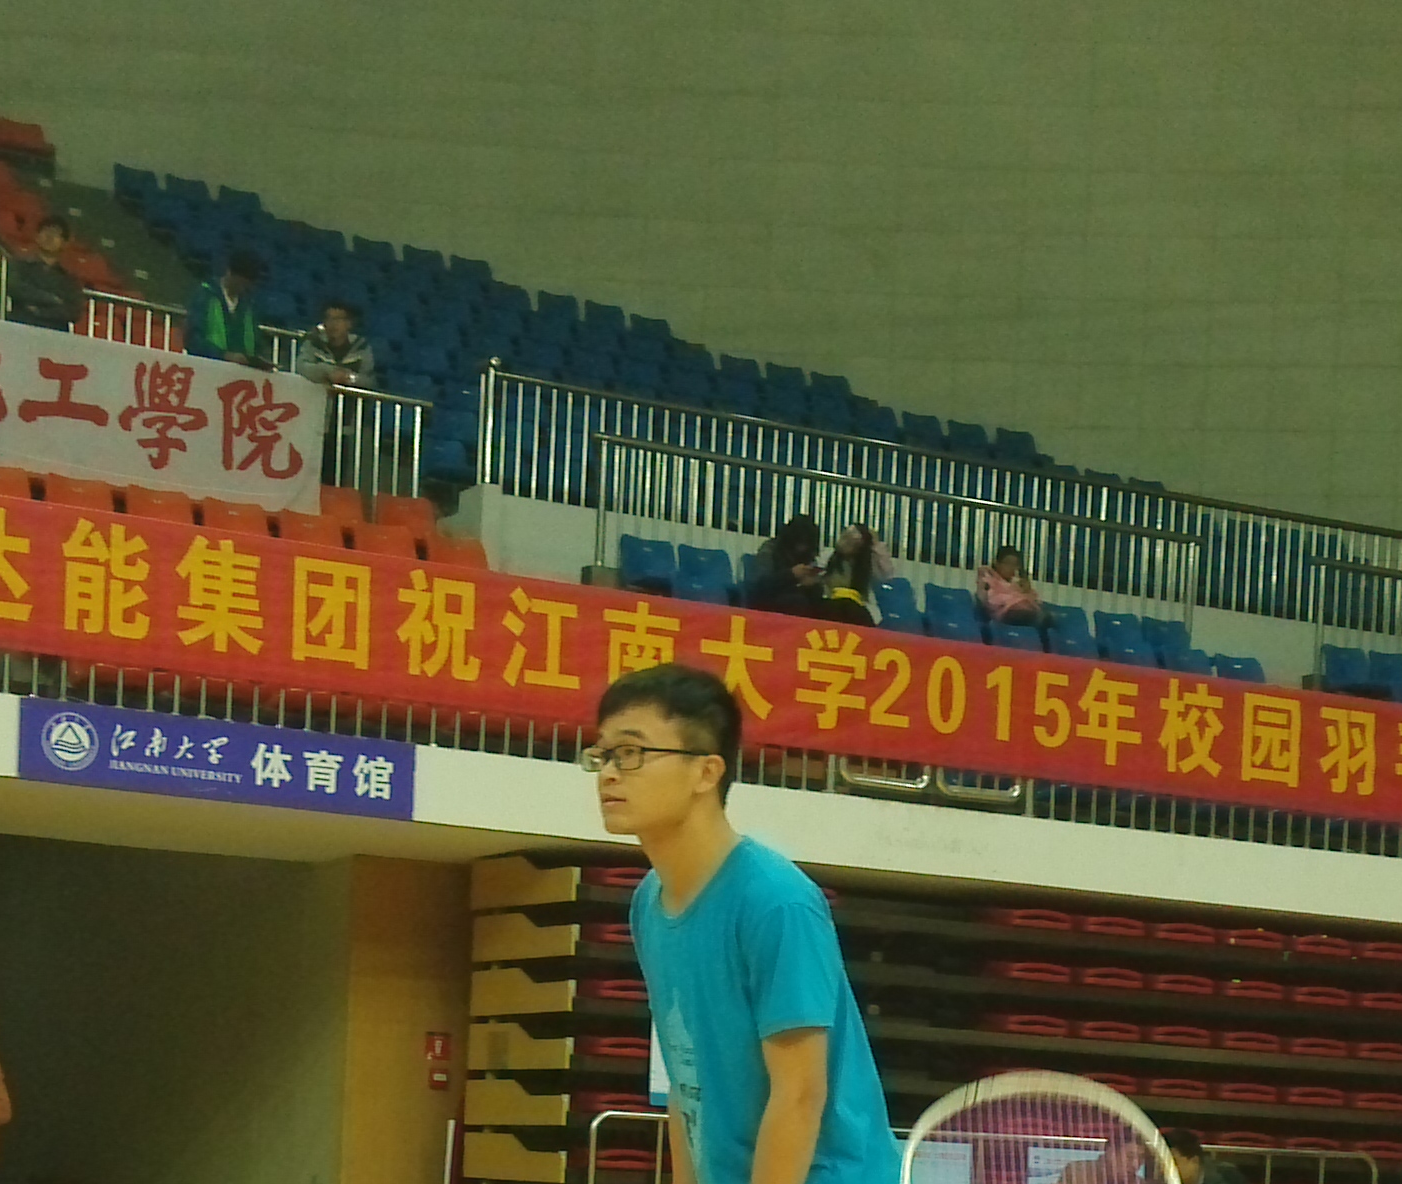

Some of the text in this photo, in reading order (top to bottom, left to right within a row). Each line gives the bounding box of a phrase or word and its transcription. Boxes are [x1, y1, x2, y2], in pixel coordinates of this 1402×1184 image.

[110, 723, 229, 765] 江南大学
[108, 759, 244, 784] JIANGNAN UNIVERSITY
[250, 743, 394, 800] 体育馆
